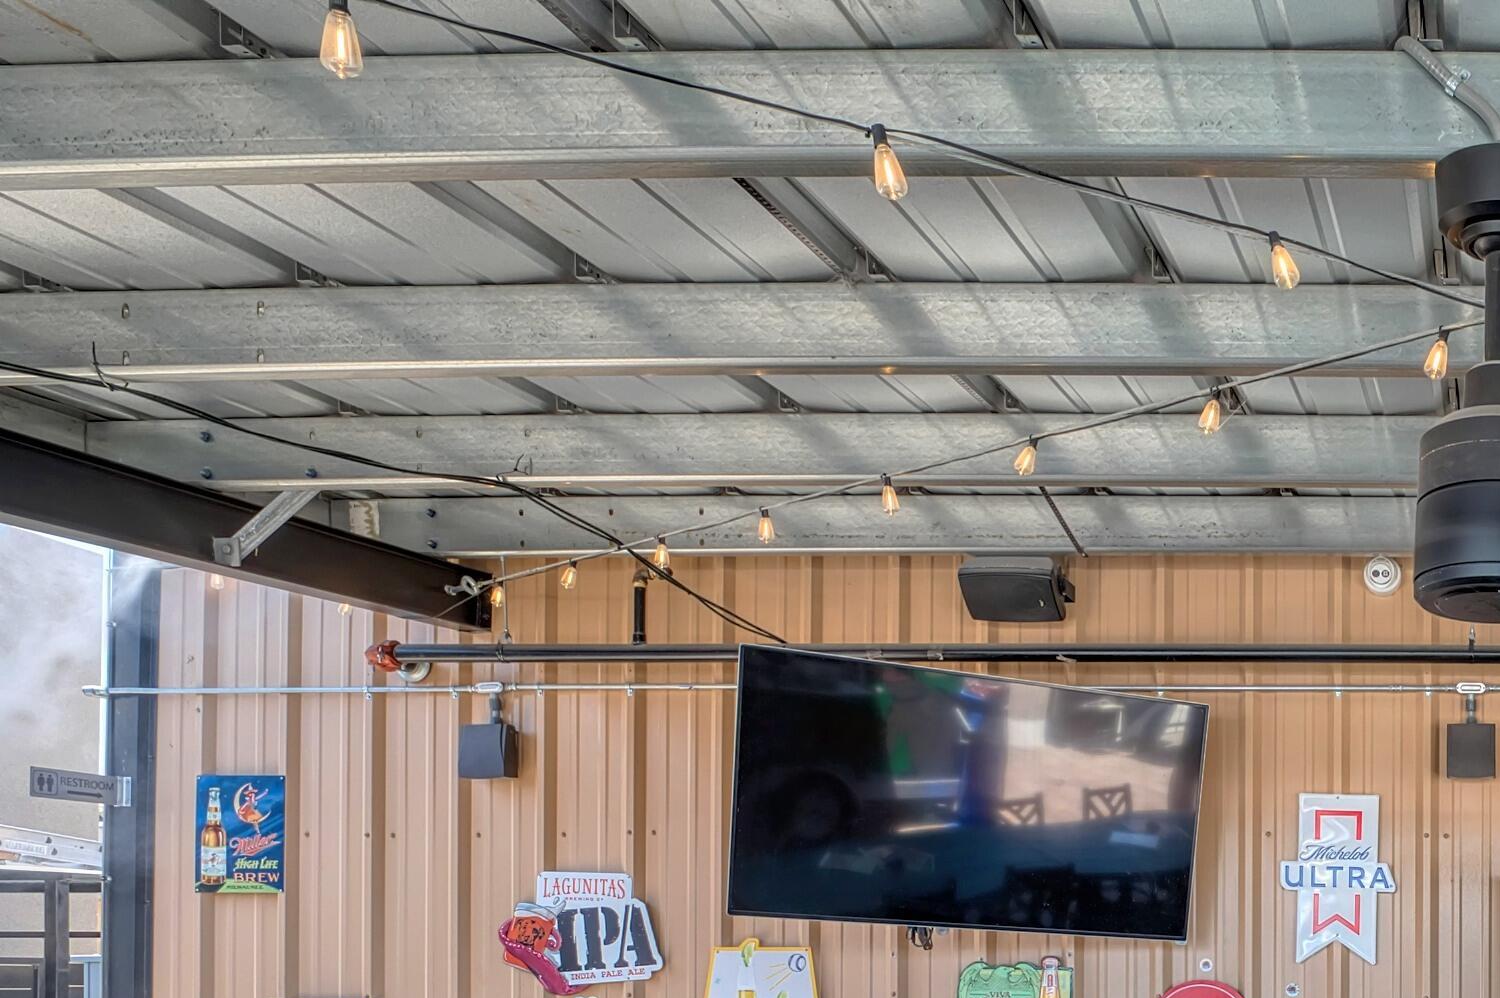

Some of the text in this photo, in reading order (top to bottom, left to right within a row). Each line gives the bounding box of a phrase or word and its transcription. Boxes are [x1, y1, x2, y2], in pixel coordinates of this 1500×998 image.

[60, 776, 115, 791] RESTROOM
[229, 833, 281, 856] Miller
[1300, 844, 1372, 861] Michelob
[233, 872, 280, 883] BREW
[1284, 865, 1390, 889] ULTRA
[543, 877, 626, 900] LAGUNITAS
[556, 904, 657, 973] IPA
[571, 967, 646, 981] INDIA PALE ALE
